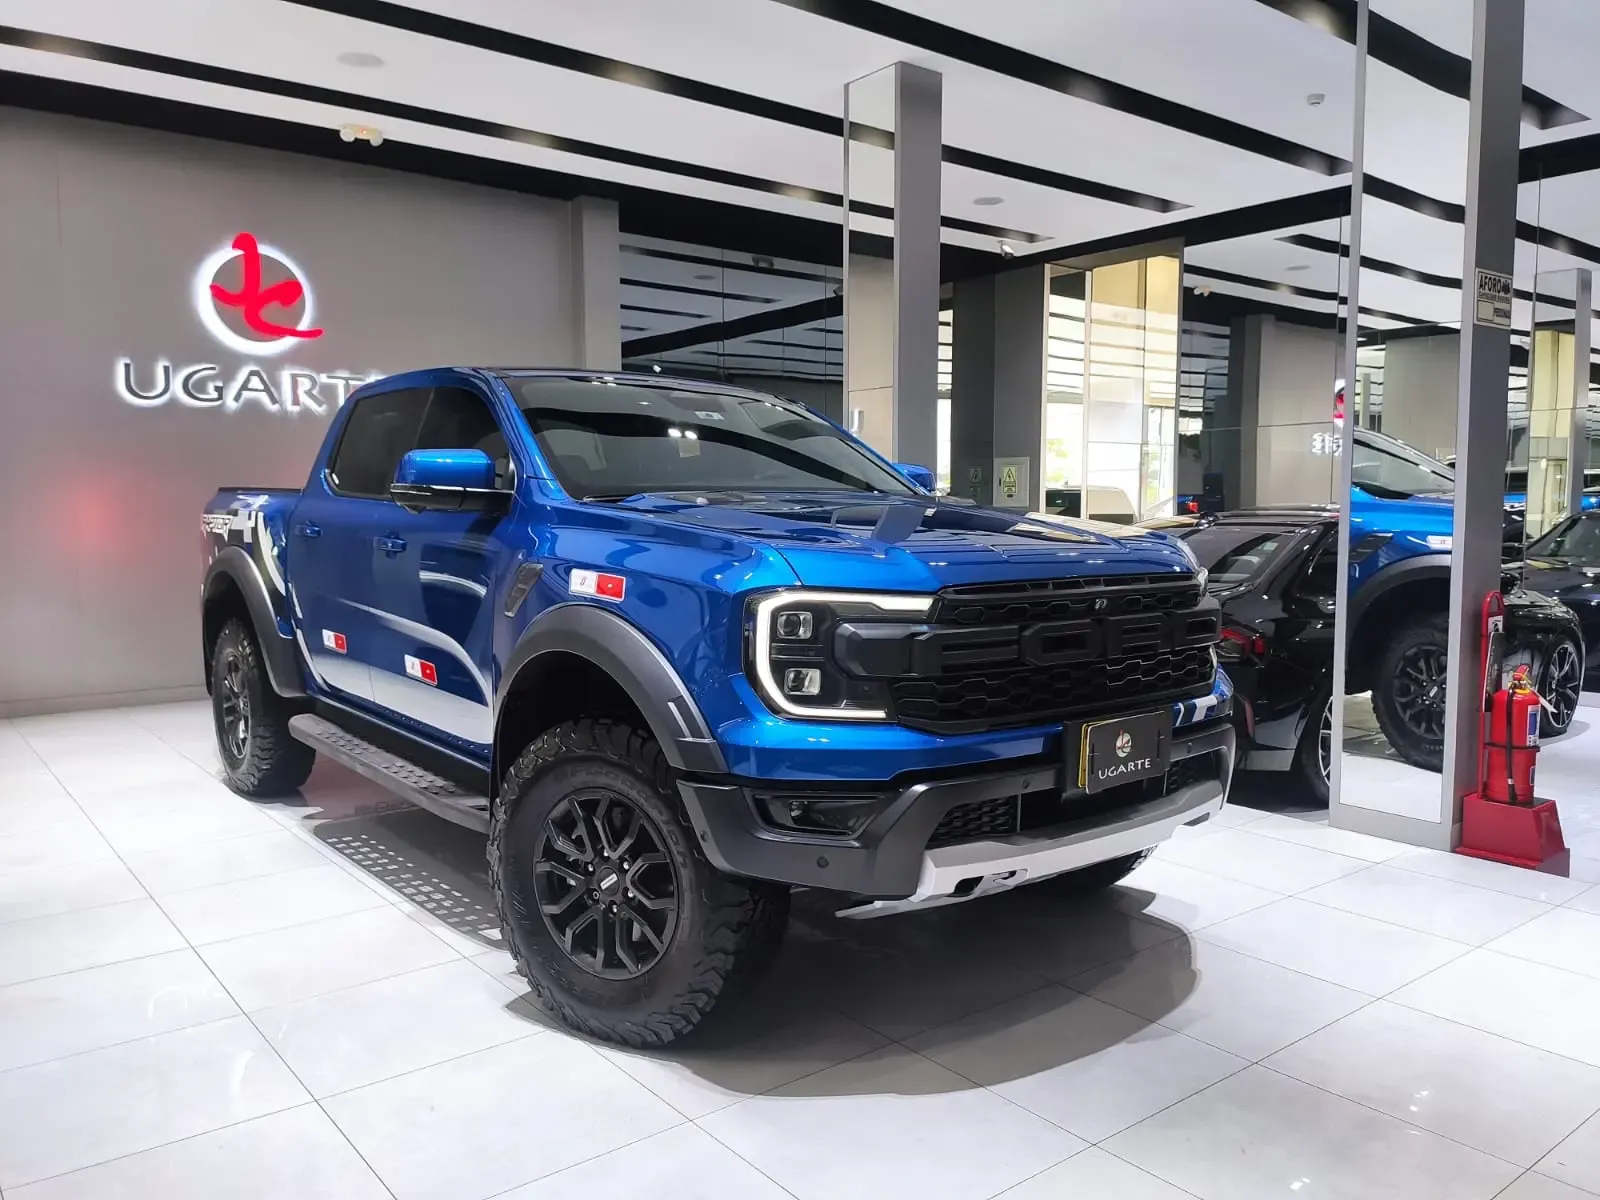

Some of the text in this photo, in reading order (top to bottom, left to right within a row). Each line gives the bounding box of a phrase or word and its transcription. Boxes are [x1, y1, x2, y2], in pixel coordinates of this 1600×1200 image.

[1479, 275, 1502, 294] AFORO
[117, 358, 386, 414] UGART
[1098, 758, 1152, 780] UGARTE
